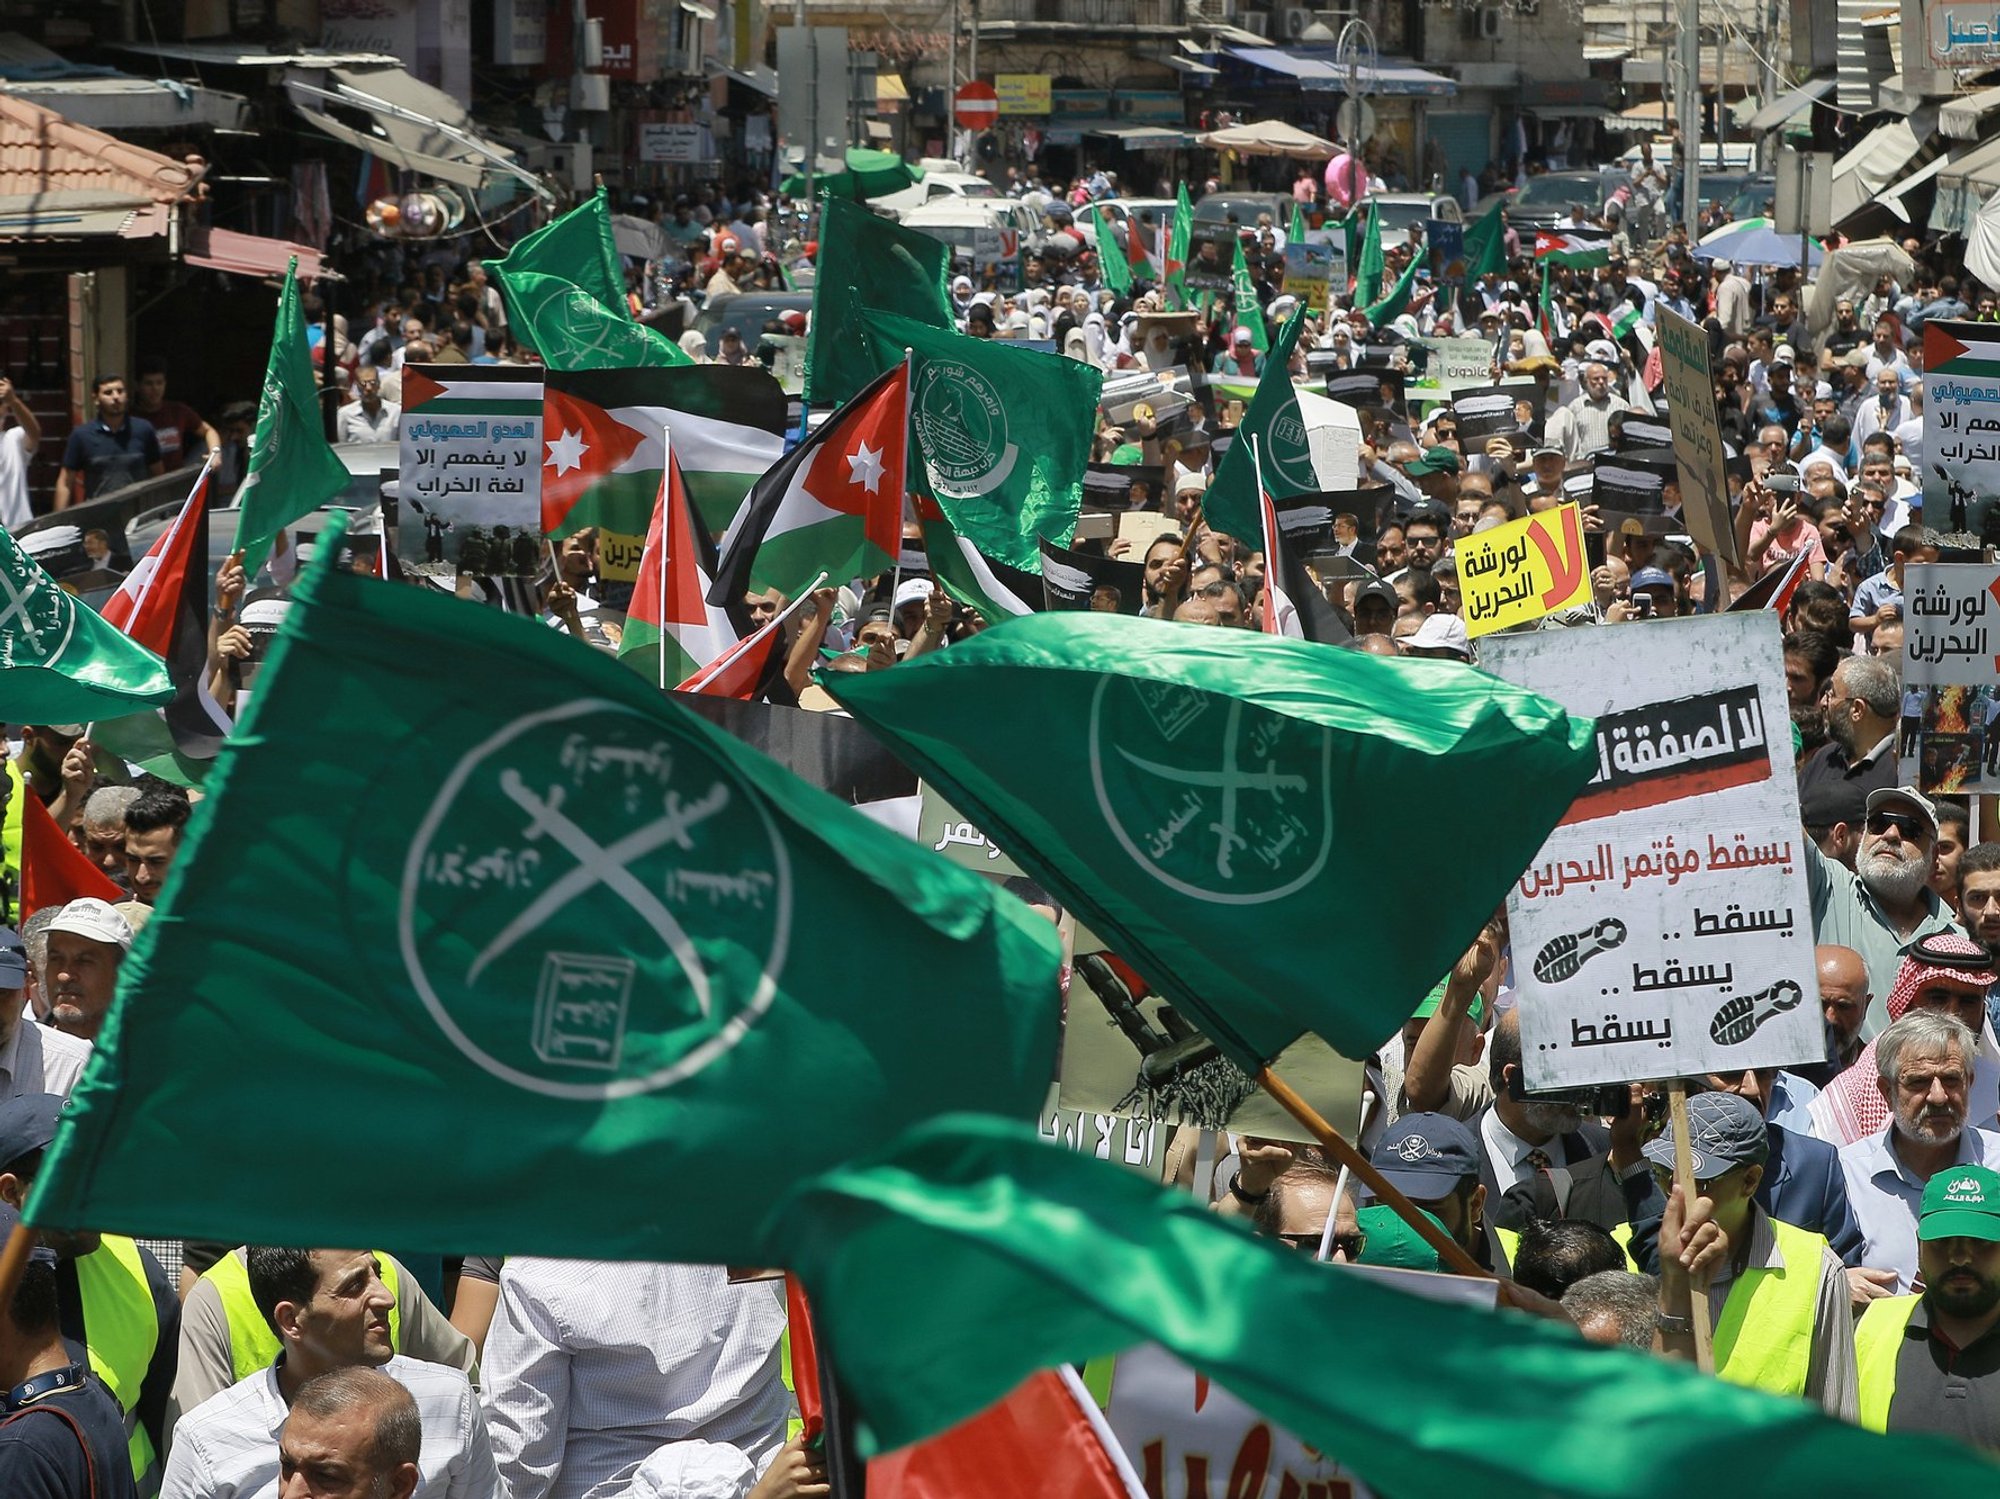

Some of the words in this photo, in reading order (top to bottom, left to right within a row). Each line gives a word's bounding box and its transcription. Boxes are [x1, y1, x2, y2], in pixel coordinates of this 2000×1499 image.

[408, 419, 488, 443] الصهيوني
[491, 421, 535, 444] العدو
[1939, 411, 1959, 433] إلا
[415, 448, 436, 469] إلا
[442, 449, 506, 470] يفهم
[513, 449, 527, 467] لا
[416, 476, 481, 498] الخراب
[487, 476, 524, 493] لغة
[605, 537, 642, 570] حرين
[1464, 535, 1527, 578] لورشة
[1526, 506, 1583, 611] لا
[1469, 571, 1534, 621] البحرين
[1912, 584, 1987, 626] لورشة
[1909, 627, 1988, 664] البحرين
[1612, 703, 1735, 775] لصفقة
[1736, 697, 1764, 750] لا
[1519, 843, 1614, 898] البحرين
[1622, 835, 1700, 890] مؤتمر
[1706, 833, 1793, 875] يسقط
[1693, 903, 1794, 939] يسقط
[1632, 958, 1734, 993] يسقط
[1570, 1013, 1672, 1048] يسقط
